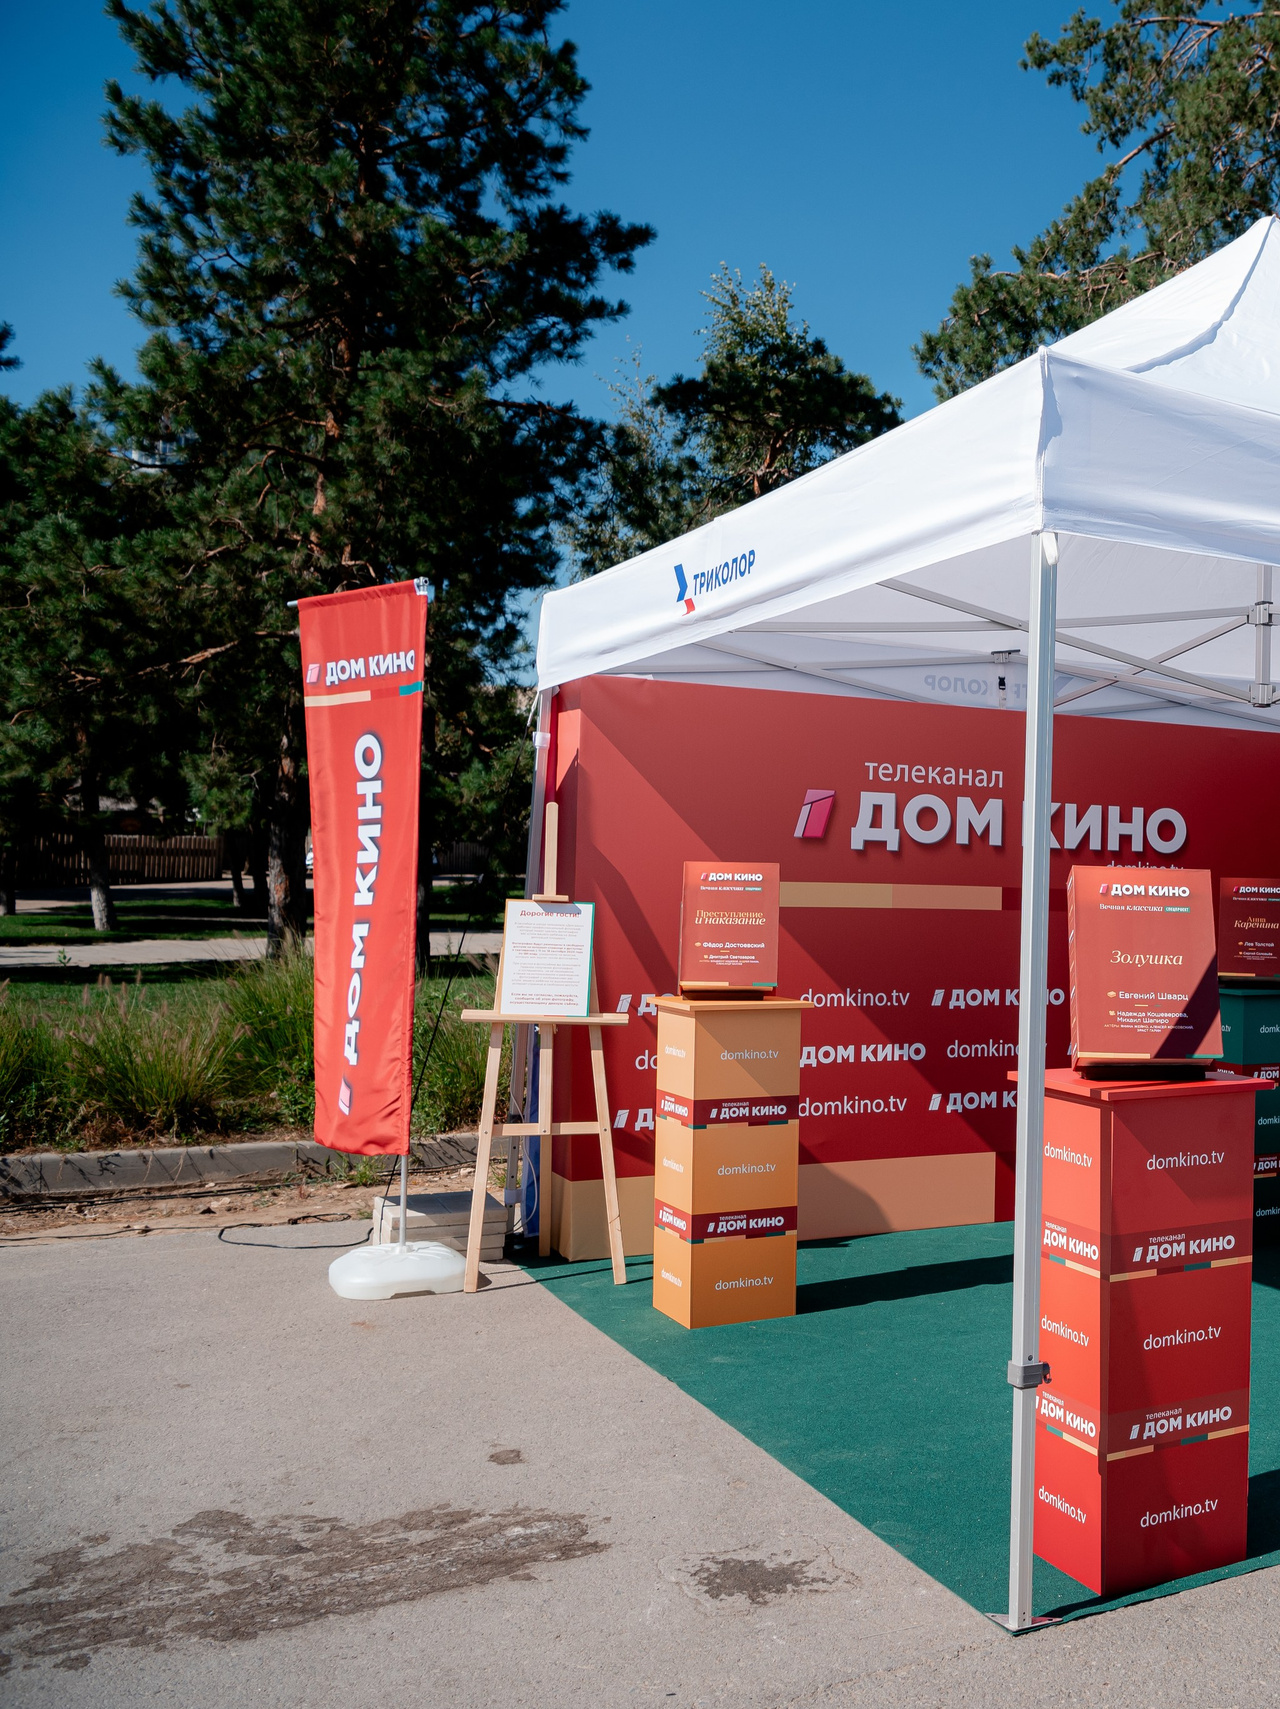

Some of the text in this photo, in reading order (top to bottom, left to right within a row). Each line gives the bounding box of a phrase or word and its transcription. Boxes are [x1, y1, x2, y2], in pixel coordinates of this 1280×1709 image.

[693, 549, 756, 595] ТРИКОЛОР
[325, 649, 416, 686] ДОМ КИНО
[865, 761, 1004, 788] телеканал
[851, 791, 1003, 851] ДОМ
[708, 873, 763, 881] ДОМ КИНО
[343, 732, 384, 1067] ДОМ КИНО
[1111, 884, 1190, 897] ДОМ КИНО
[696, 910, 763, 918] Преступление
[704, 917, 766, 925] наказание
[1234, 920, 1280, 930] Каренина
[1110, 950, 1184, 967] Золушка
[800, 988, 910, 1008] domkino.tv
[949, 989, 1000, 1009] ДОМ
[1119, 991, 1189, 1001] Евгений Шварц
[720, 1049, 779, 1061] domkino.tv
[800, 1043, 926, 1067] ДОМ КИНО
[1260, 1070, 1279, 1080] ДОМ
[798, 1095, 907, 1117] domkino.tv
[946, 1091, 997, 1113] ДОМ
[720, 1105, 787, 1120] ДОМ КИНО
[1044, 1142, 1092, 1168] domkino.tv
[1147, 1151, 1225, 1170] domkino.tv
[717, 1162, 776, 1176] domkino.tv
[1257, 1160, 1277, 1171] ДОМ
[717, 1216, 784, 1233] ДОМ КИНО
[1043, 1229, 1099, 1260] ДОМ КИНО
[1149, 1233, 1186, 1244] телеканал
[1146, 1235, 1235, 1263] ДОМ КИНО
[715, 1275, 774, 1291] domkino.tv
[1041, 1315, 1089, 1347] domkino.tv
[1143, 1326, 1221, 1350] domkino.tv
[1041, 1398, 1096, 1438] ДОМ КИНО
[1143, 1406, 1232, 1440] ДОМ КИНО
[1146, 1408, 1182, 1420] телеканал
[1039, 1486, 1087, 1524] domkino.tv
[1140, 1499, 1219, 1528] domkino.tv
